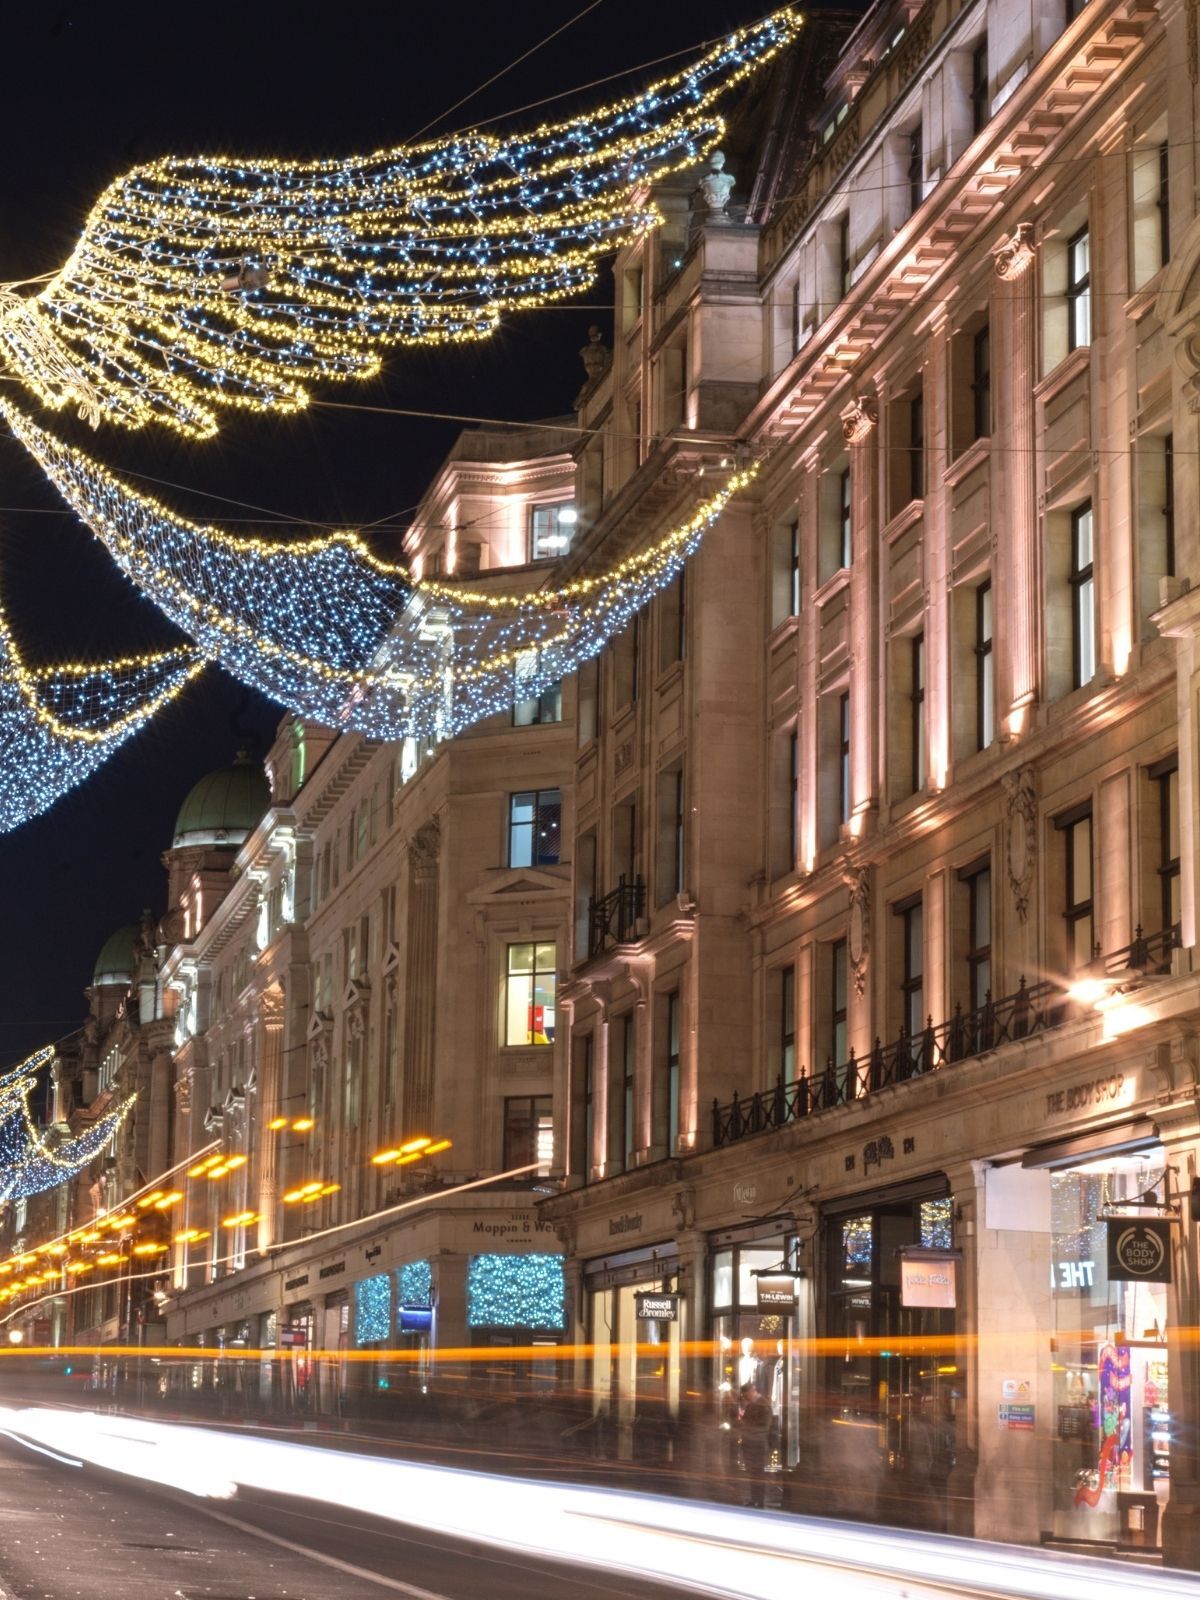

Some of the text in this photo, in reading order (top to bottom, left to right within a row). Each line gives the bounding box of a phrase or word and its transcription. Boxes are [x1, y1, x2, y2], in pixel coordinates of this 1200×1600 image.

[1046, 1089, 1065, 1114] THE
[1066, 1081, 1095, 1111] BODY
[473, 1220, 518, 1236] Mappin
[522, 1221, 530, 1233] &
[1131, 1241, 1150, 1250] THE
[1126, 1248, 1156, 1258] BODY
[1127, 1257, 1155, 1267] SHOP
[643, 1299, 672, 1310] Russell
